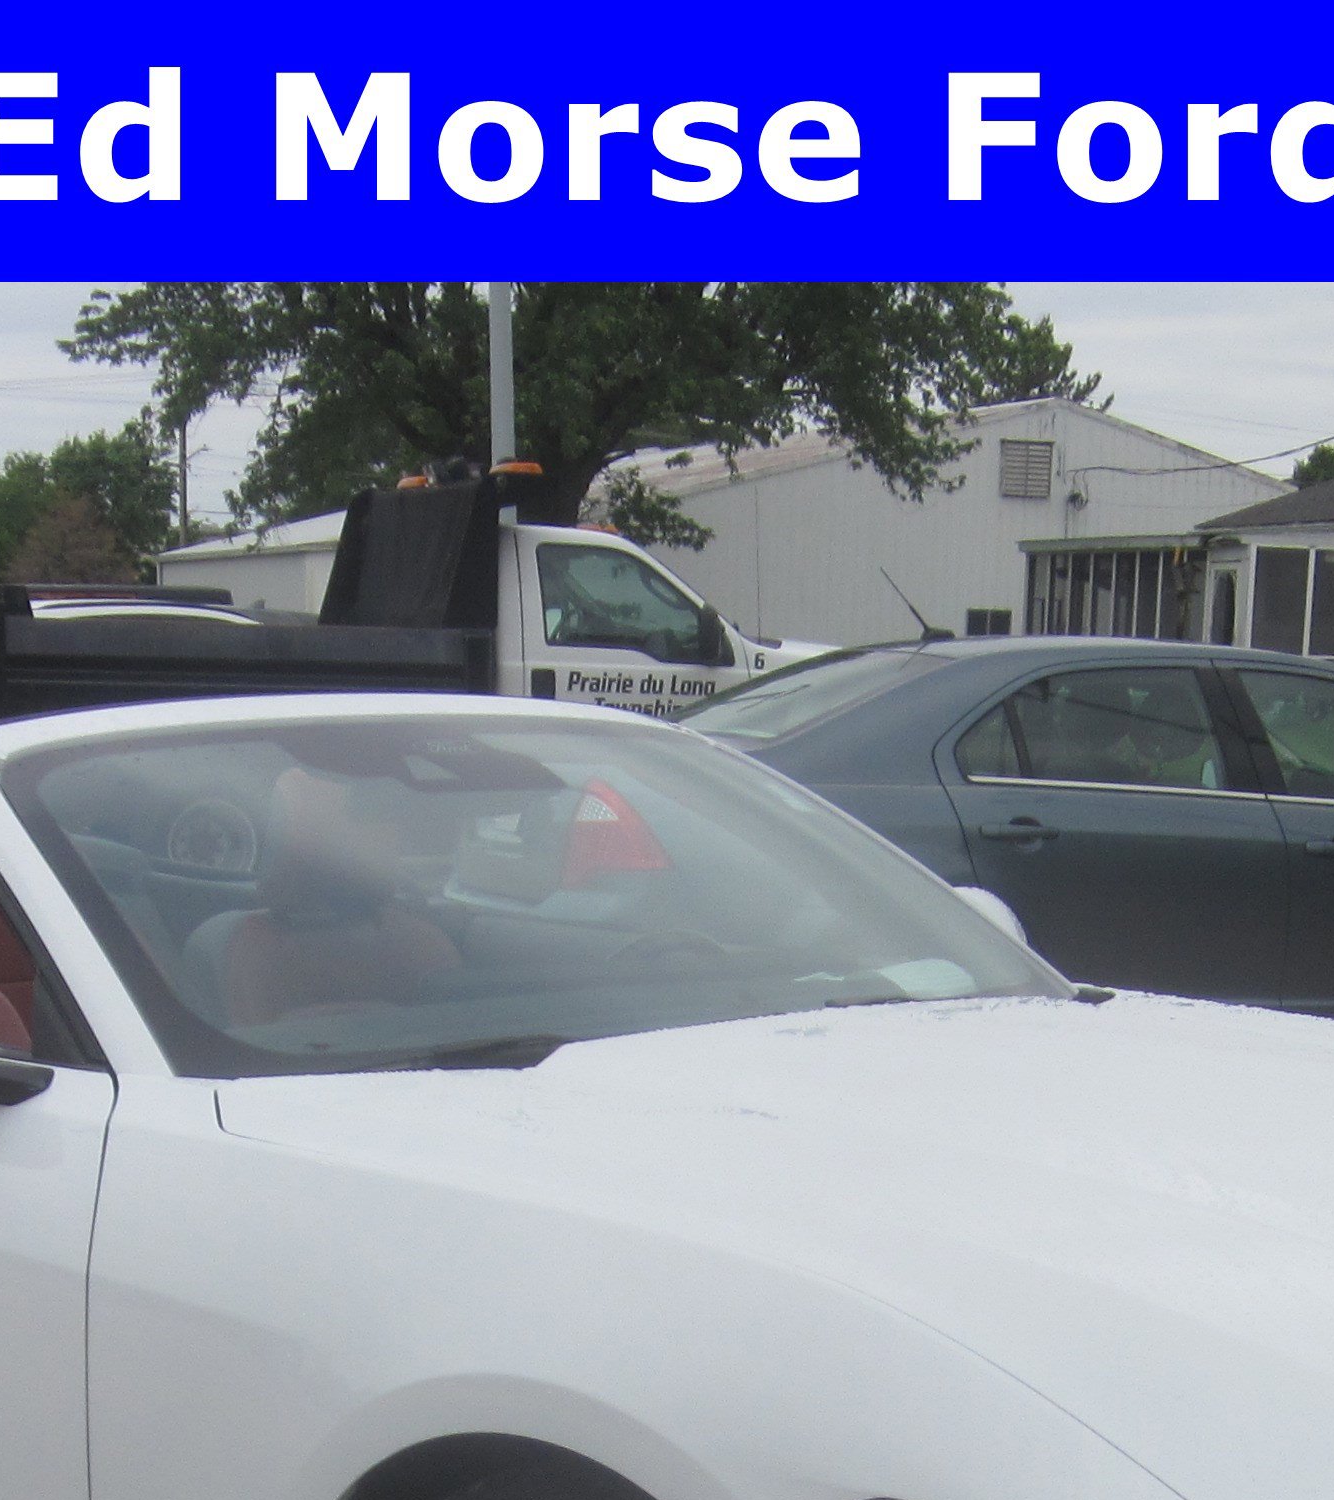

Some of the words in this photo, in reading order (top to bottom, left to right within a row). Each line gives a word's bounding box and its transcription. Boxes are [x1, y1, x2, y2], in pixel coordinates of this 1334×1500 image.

[754, 652, 766, 670] 6
[567, 671, 634, 694] Prairie
[639, 673, 665, 694] du
[670, 674, 716, 698] Long
[593, 697, 685, 718] Tnshi
